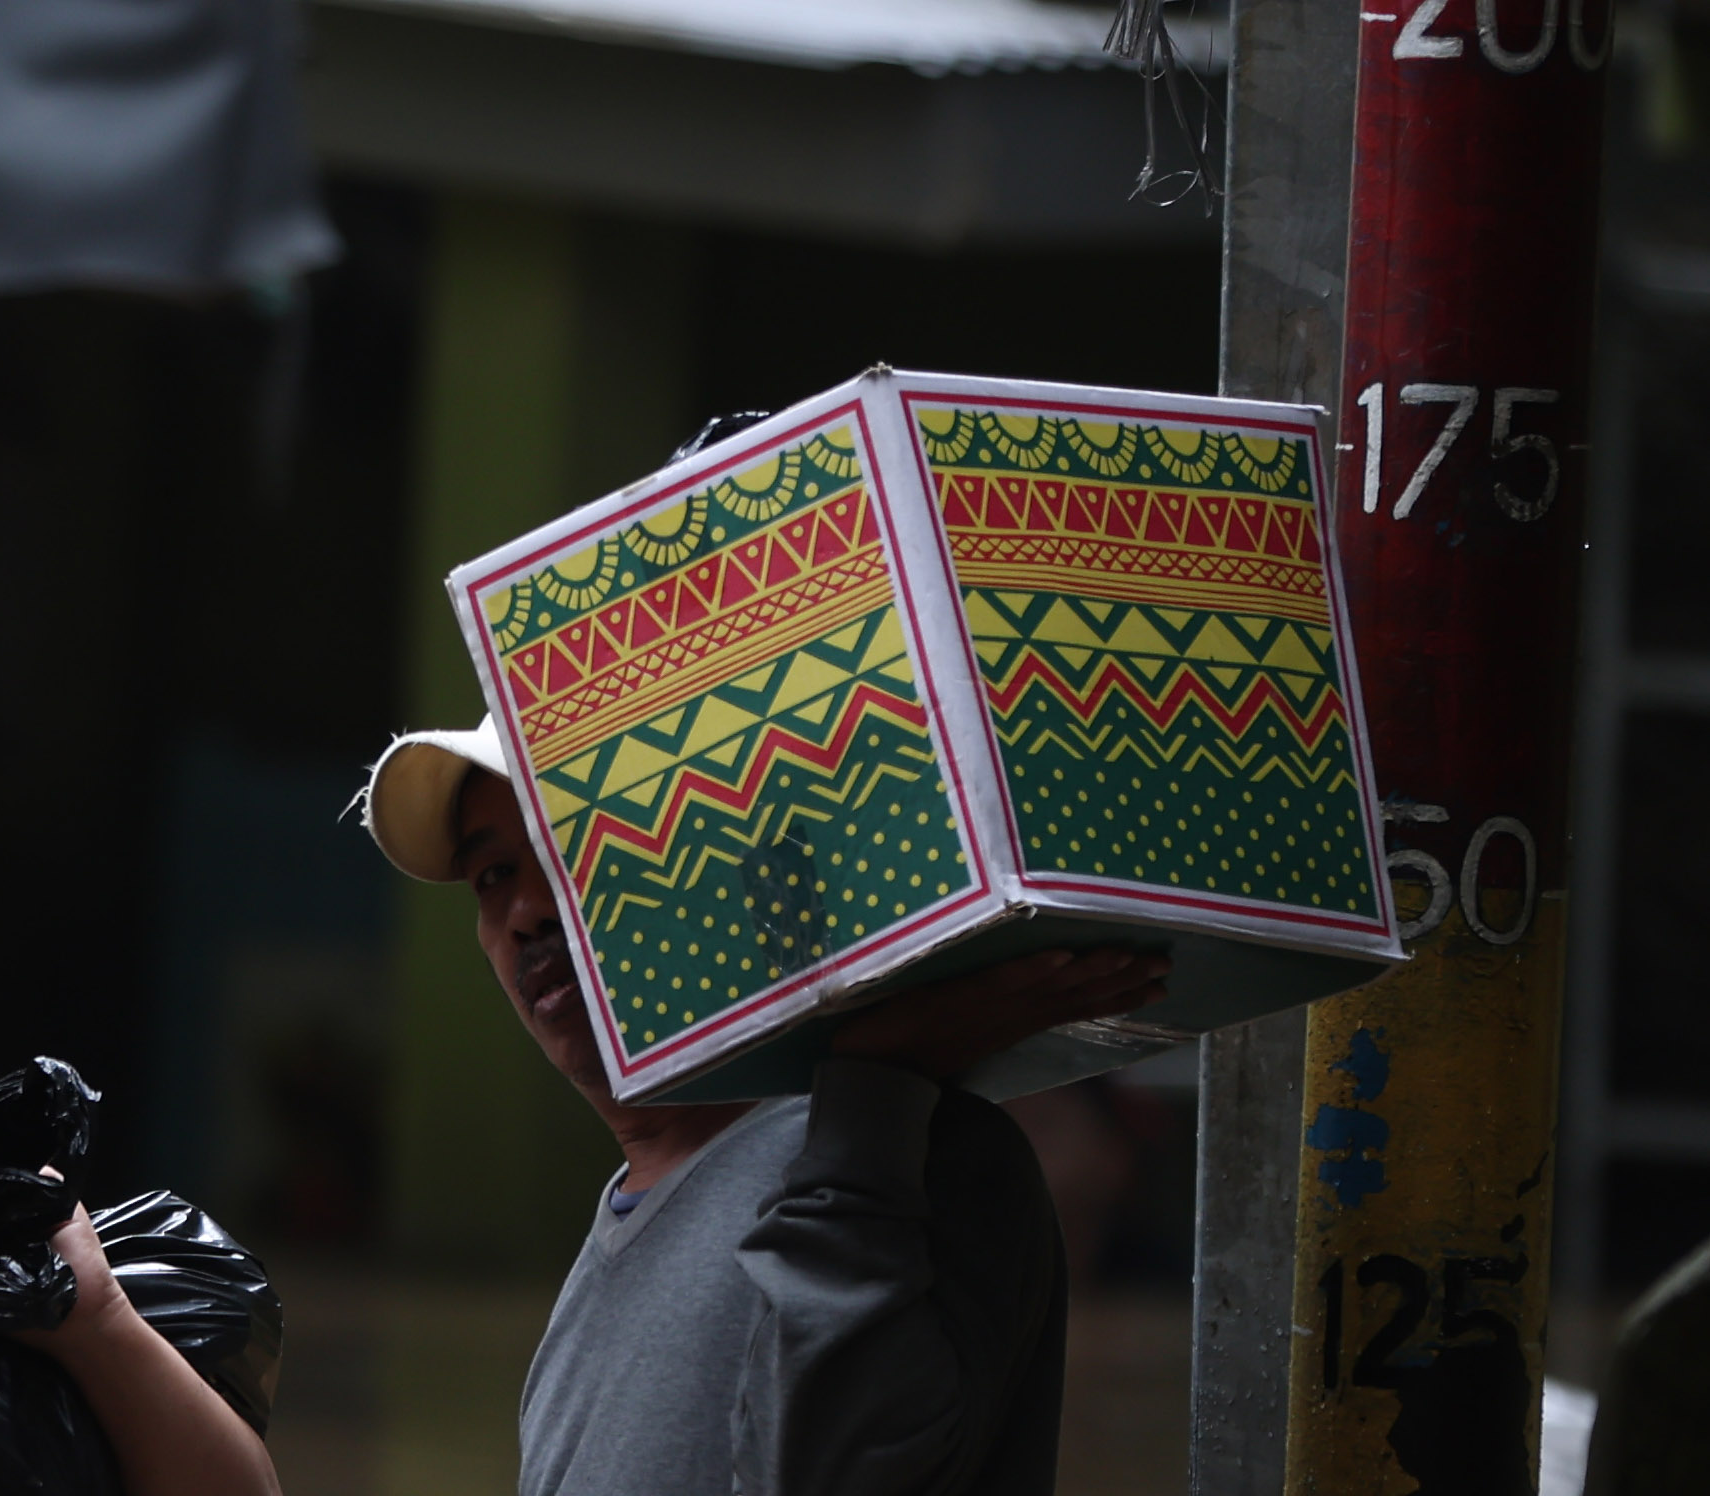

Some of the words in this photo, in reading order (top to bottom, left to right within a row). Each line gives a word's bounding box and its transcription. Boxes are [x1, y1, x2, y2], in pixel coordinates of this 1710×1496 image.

[1357, 382, 1561, 523] 175
[1377, 801, 1537, 945] 50
[1317, 1253, 1529, 1390] 125
